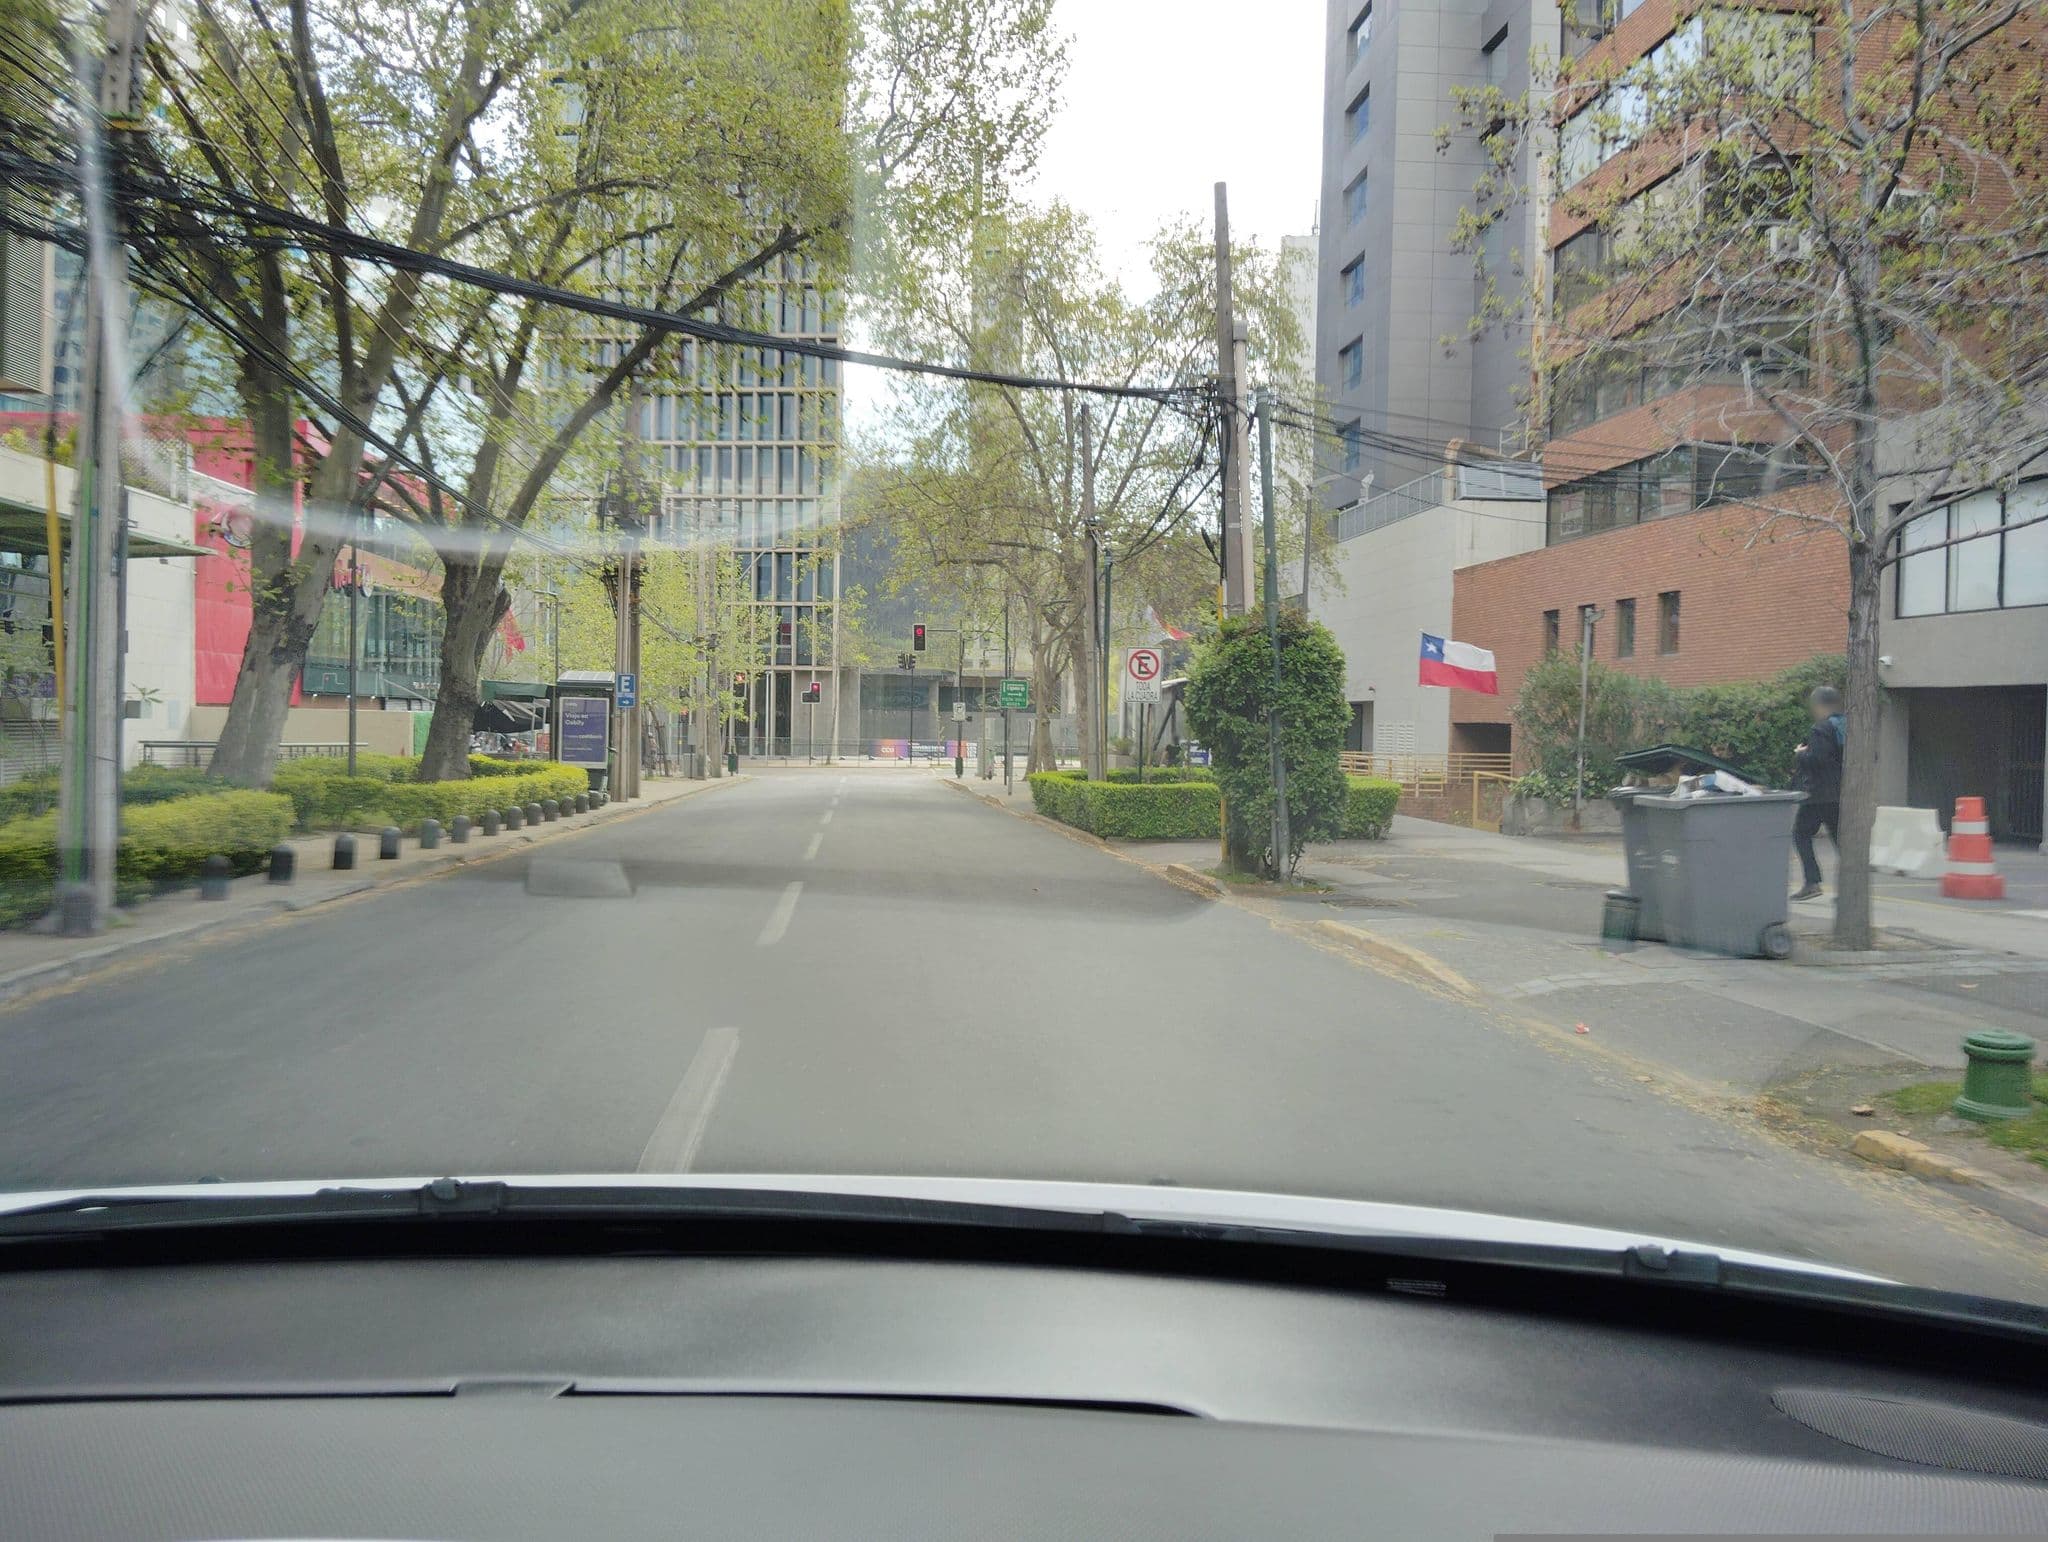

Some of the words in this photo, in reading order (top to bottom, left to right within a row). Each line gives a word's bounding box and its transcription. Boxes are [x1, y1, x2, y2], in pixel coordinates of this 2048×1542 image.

[1138, 656, 1151, 674] E
[621, 676, 631, 693] E
[1136, 681, 1150, 690] TODA
[1127, 691, 1135, 700] LA
[1135, 691, 1159, 700] CUADRA
